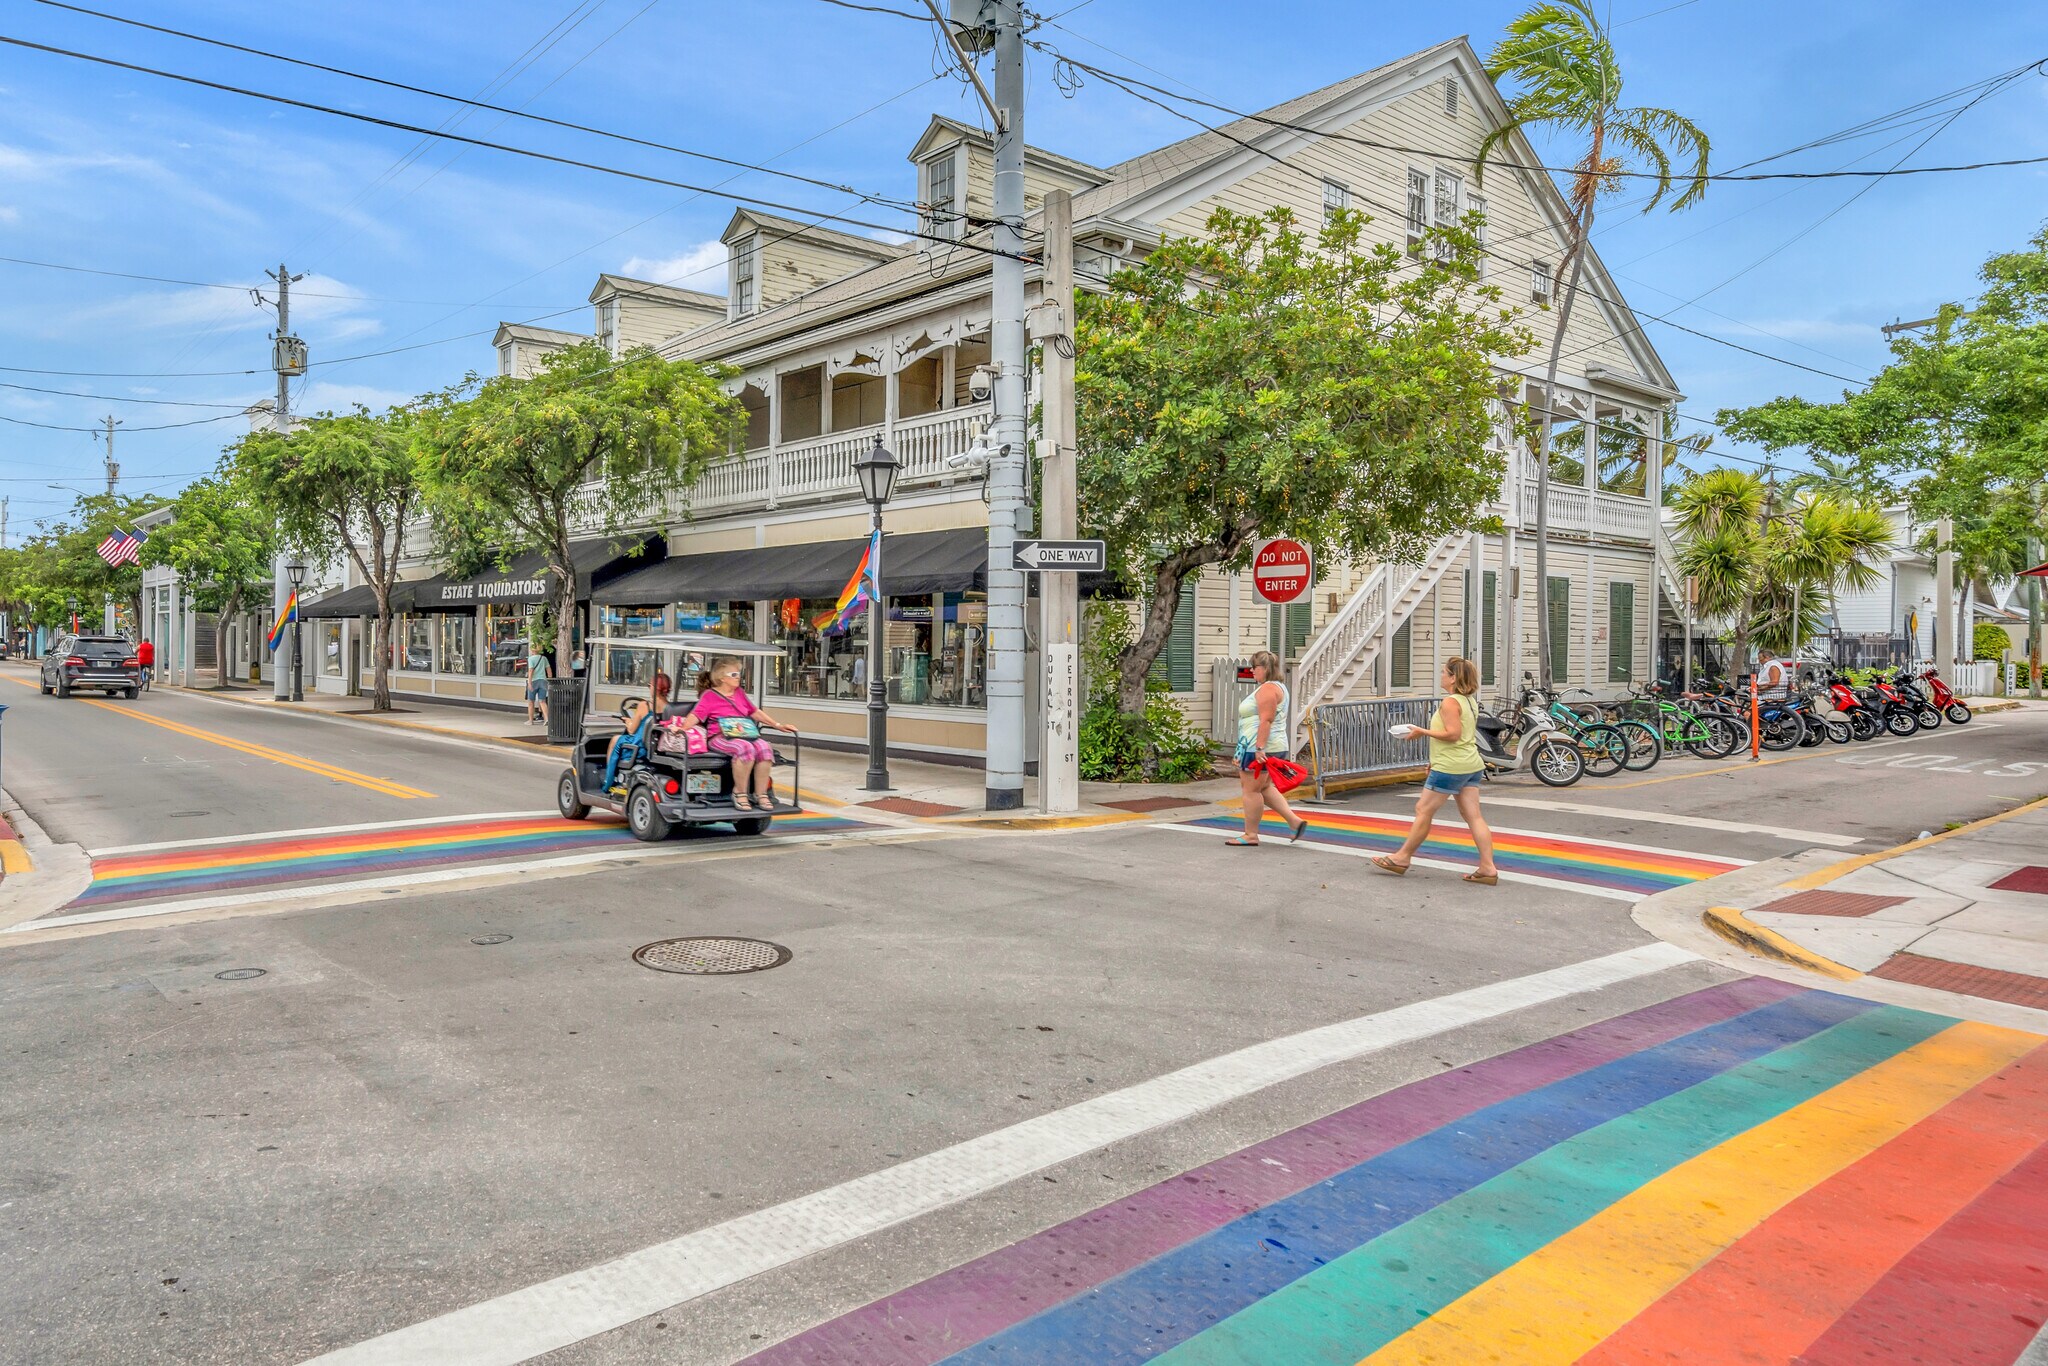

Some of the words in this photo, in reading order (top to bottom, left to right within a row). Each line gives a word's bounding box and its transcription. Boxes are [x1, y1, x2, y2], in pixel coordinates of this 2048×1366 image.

[1039, 549, 1064, 561] ONE
[1068, 549, 1093, 561] WAY
[1262, 552, 1276, 563] DO
[1281, 550, 1302, 562] NOT
[441, 584, 474, 599] ESTATE
[477, 579, 546, 599] LIQUIDATORS
[1265, 580, 1298, 591] ENTER
[1064, 753, 1074, 762] ST
